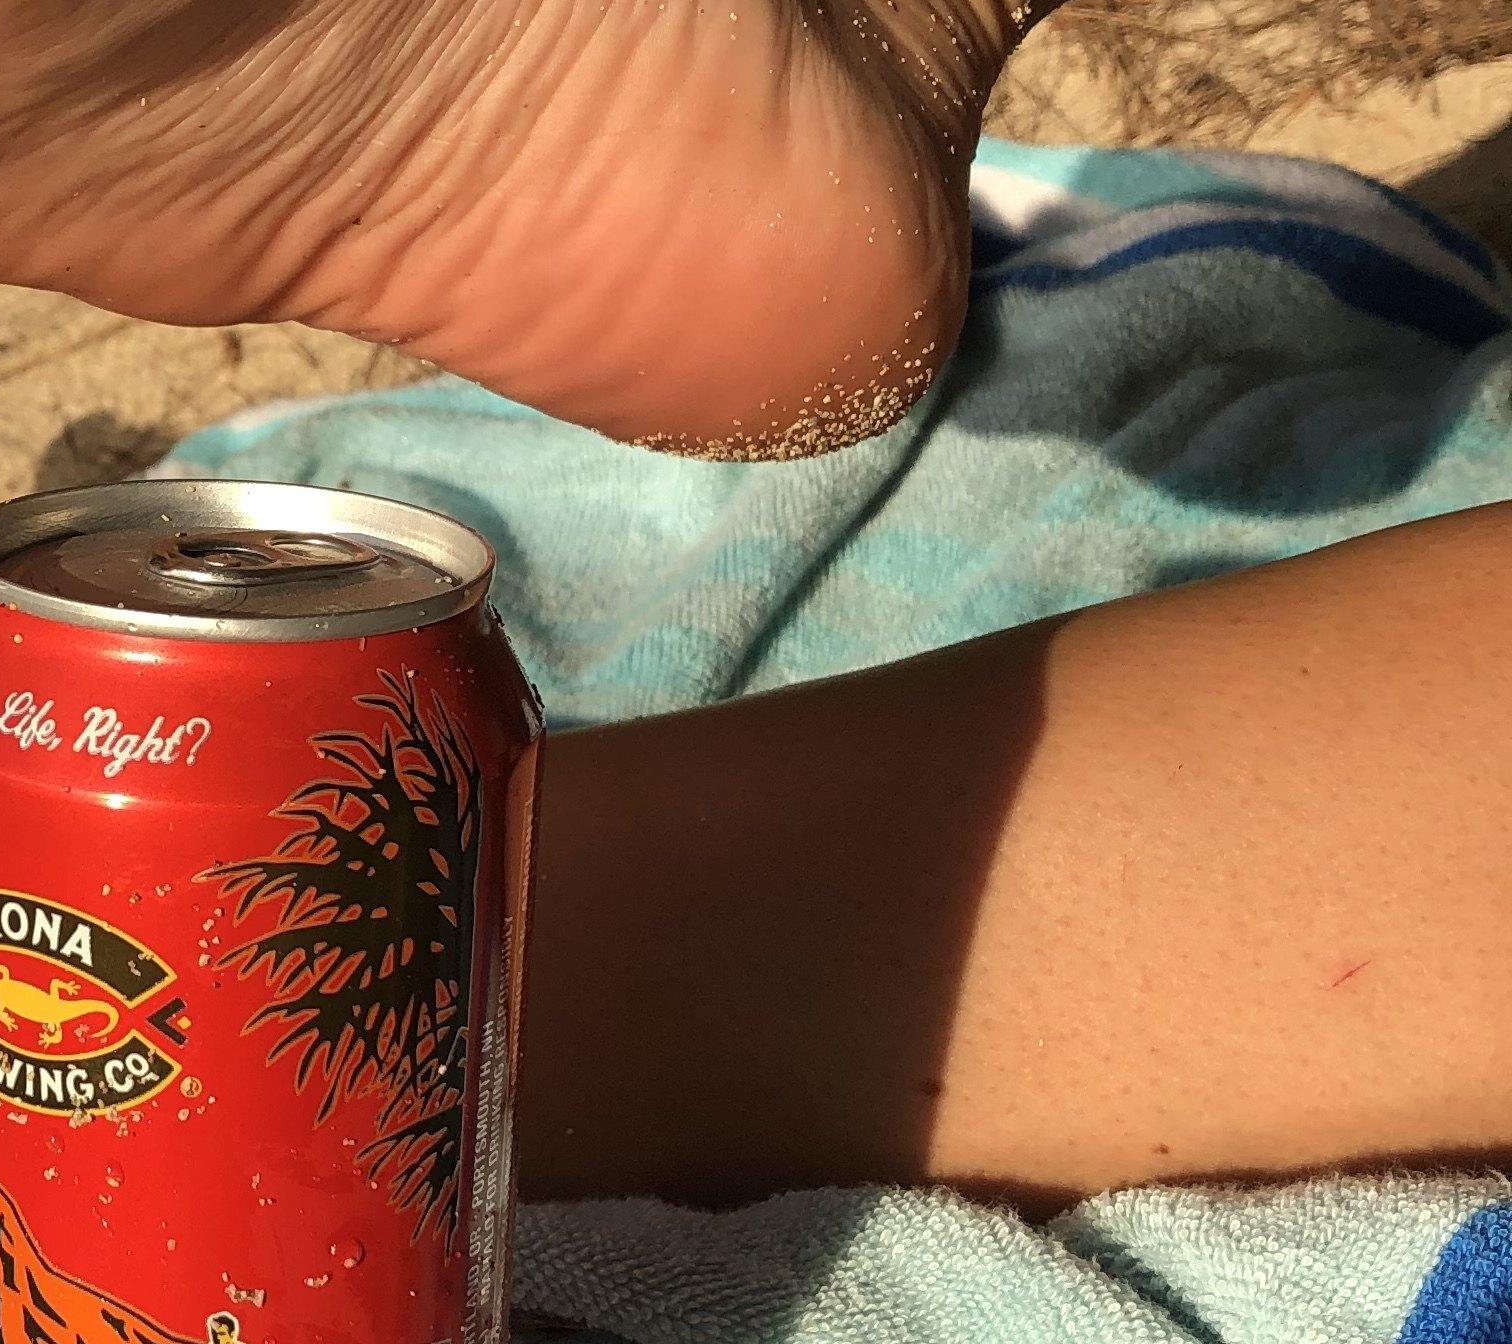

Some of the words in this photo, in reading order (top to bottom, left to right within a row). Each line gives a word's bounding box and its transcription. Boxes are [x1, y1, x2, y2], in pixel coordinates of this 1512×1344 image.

[71, 705, 213, 779] Right?
[494, 916, 514, 1059] RESPONSIBLY
[468, 1227, 482, 1258] OR
[481, 1021, 494, 1053] NH
[488, 1063, 505, 1167] DRINKING
[485, 1169, 498, 1213] FOR
[480, 1215, 496, 1306] MAHALO
